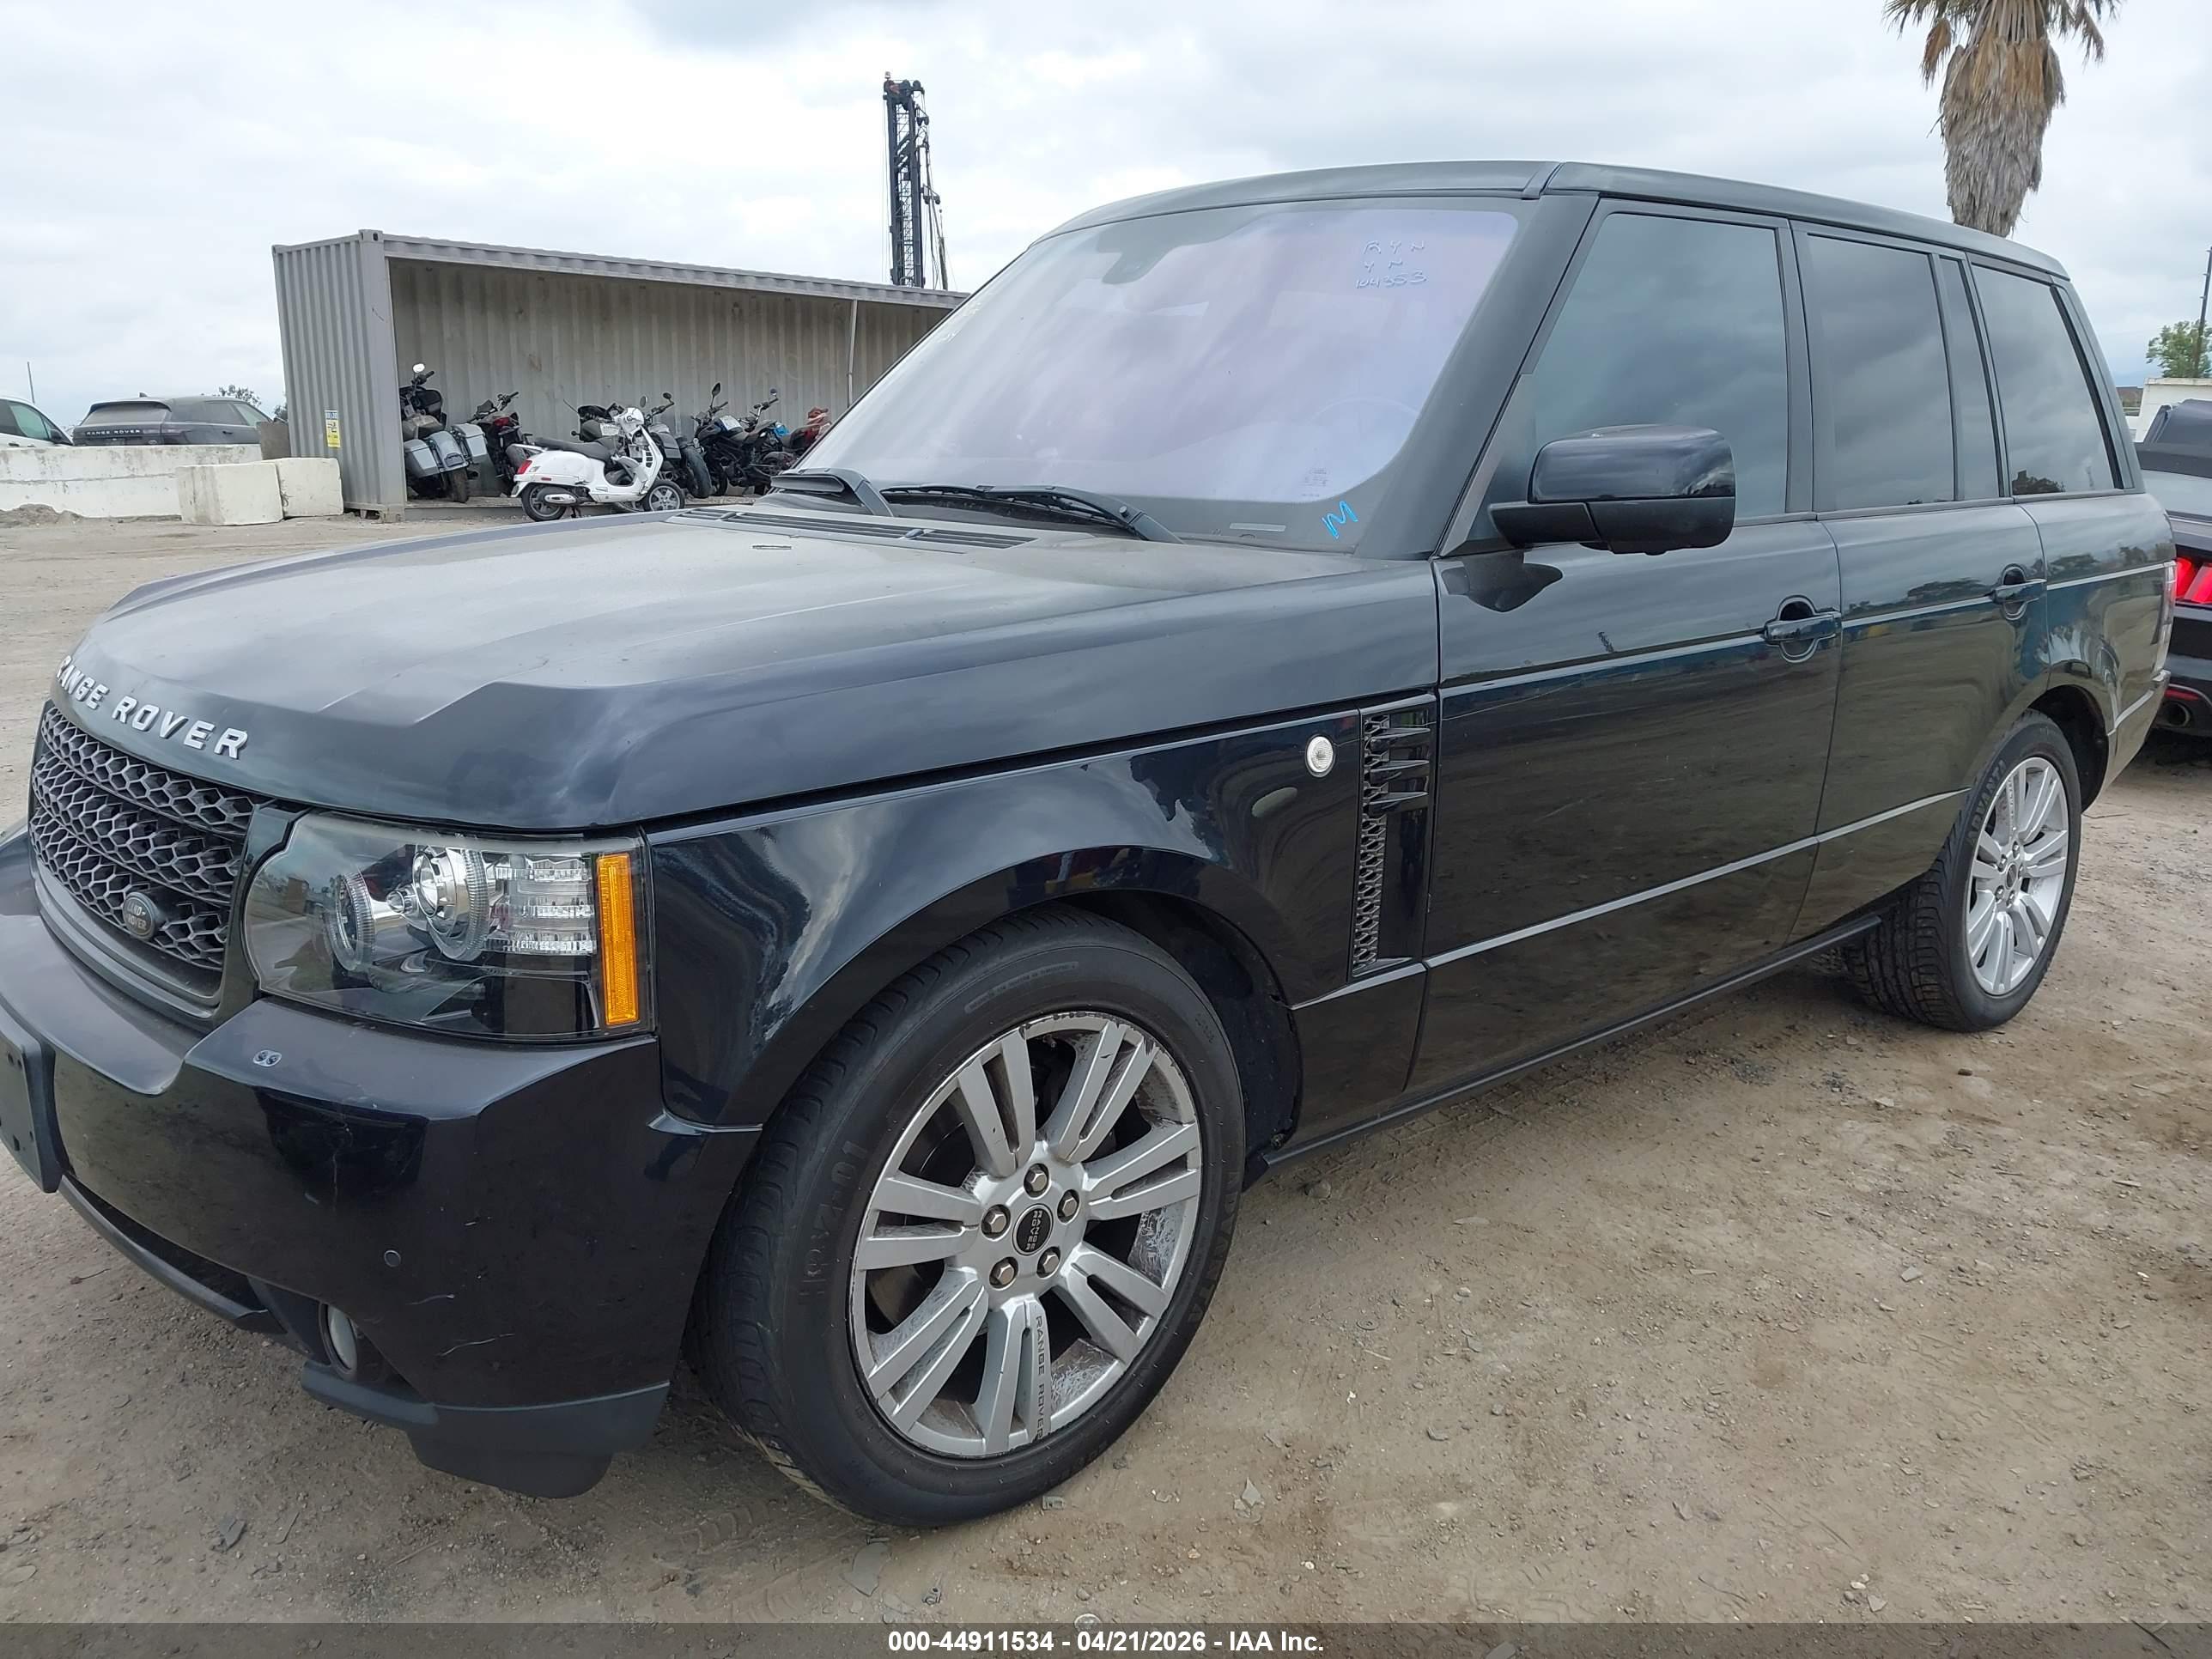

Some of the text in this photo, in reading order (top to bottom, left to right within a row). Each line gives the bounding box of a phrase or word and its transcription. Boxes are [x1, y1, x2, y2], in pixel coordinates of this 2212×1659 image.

[56, 654, 249, 760] RANGE ROVER
[1024, 1209, 1038, 1251] ROVER
[1030, 1209, 1043, 1250] RANGE
[1036, 1315, 1046, 1440] RANGE ROVER
